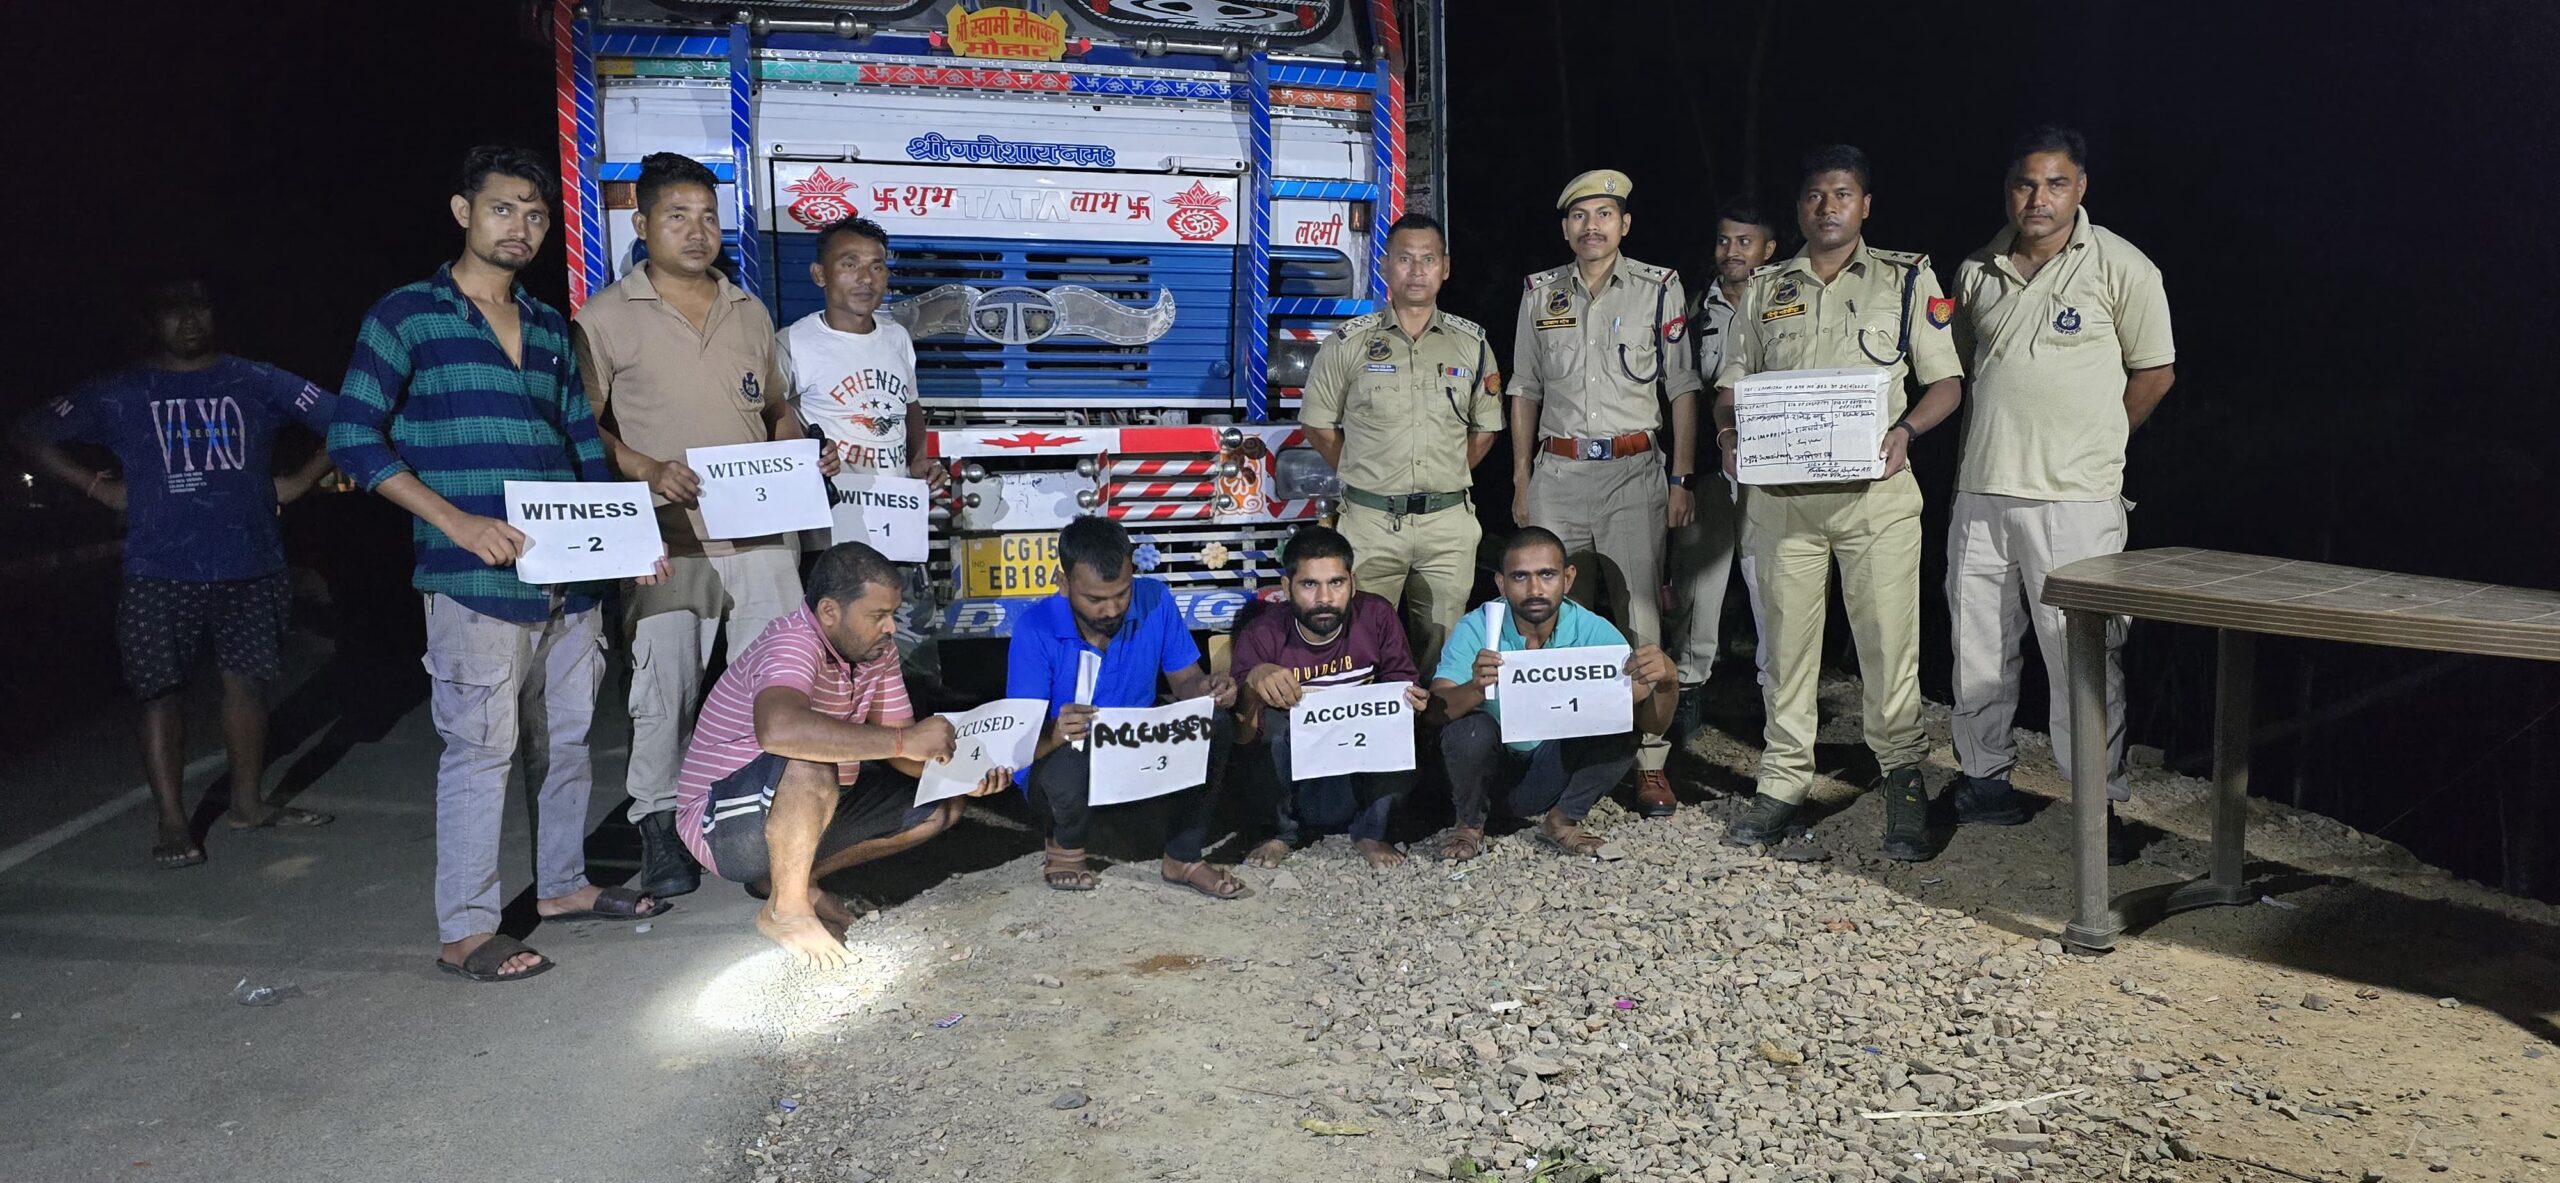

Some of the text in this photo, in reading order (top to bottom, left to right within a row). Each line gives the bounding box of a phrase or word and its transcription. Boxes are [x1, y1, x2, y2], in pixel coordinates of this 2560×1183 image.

[902, 185, 956, 216] शुभ
[957, 188, 1070, 222] TATA
[1070, 190, 1122, 214] लाभ
[1295, 212, 1343, 246] लक्ष्मी
[829, 368, 911, 406] FRIENDS
[150, 395, 246, 475] VIXO
[835, 439, 907, 469] FOREVE
[707, 456, 794, 480] WITNESS
[755, 487, 767, 502] 3
[839, 489, 919, 510] WITNESS
[521, 502, 638, 521] WITNESS
[882, 523, 891, 537] 1
[588, 536, 604, 552] 2
[1003, 537, 1059, 562] CG15
[989, 564, 1060, 591] EB184
[1511, 663, 1617, 685] ACCUSED
[1302, 699, 1400, 725] ACCUSED
[1568, 697, 1579, 713] 1
[955, 715, 1014, 740] CCUSED
[1094, 714, 1216, 749] ACCUSED
[970, 745, 981, 760] 4
[1354, 733, 1366, 748] 2
[1156, 755, 1168, 771] 3
